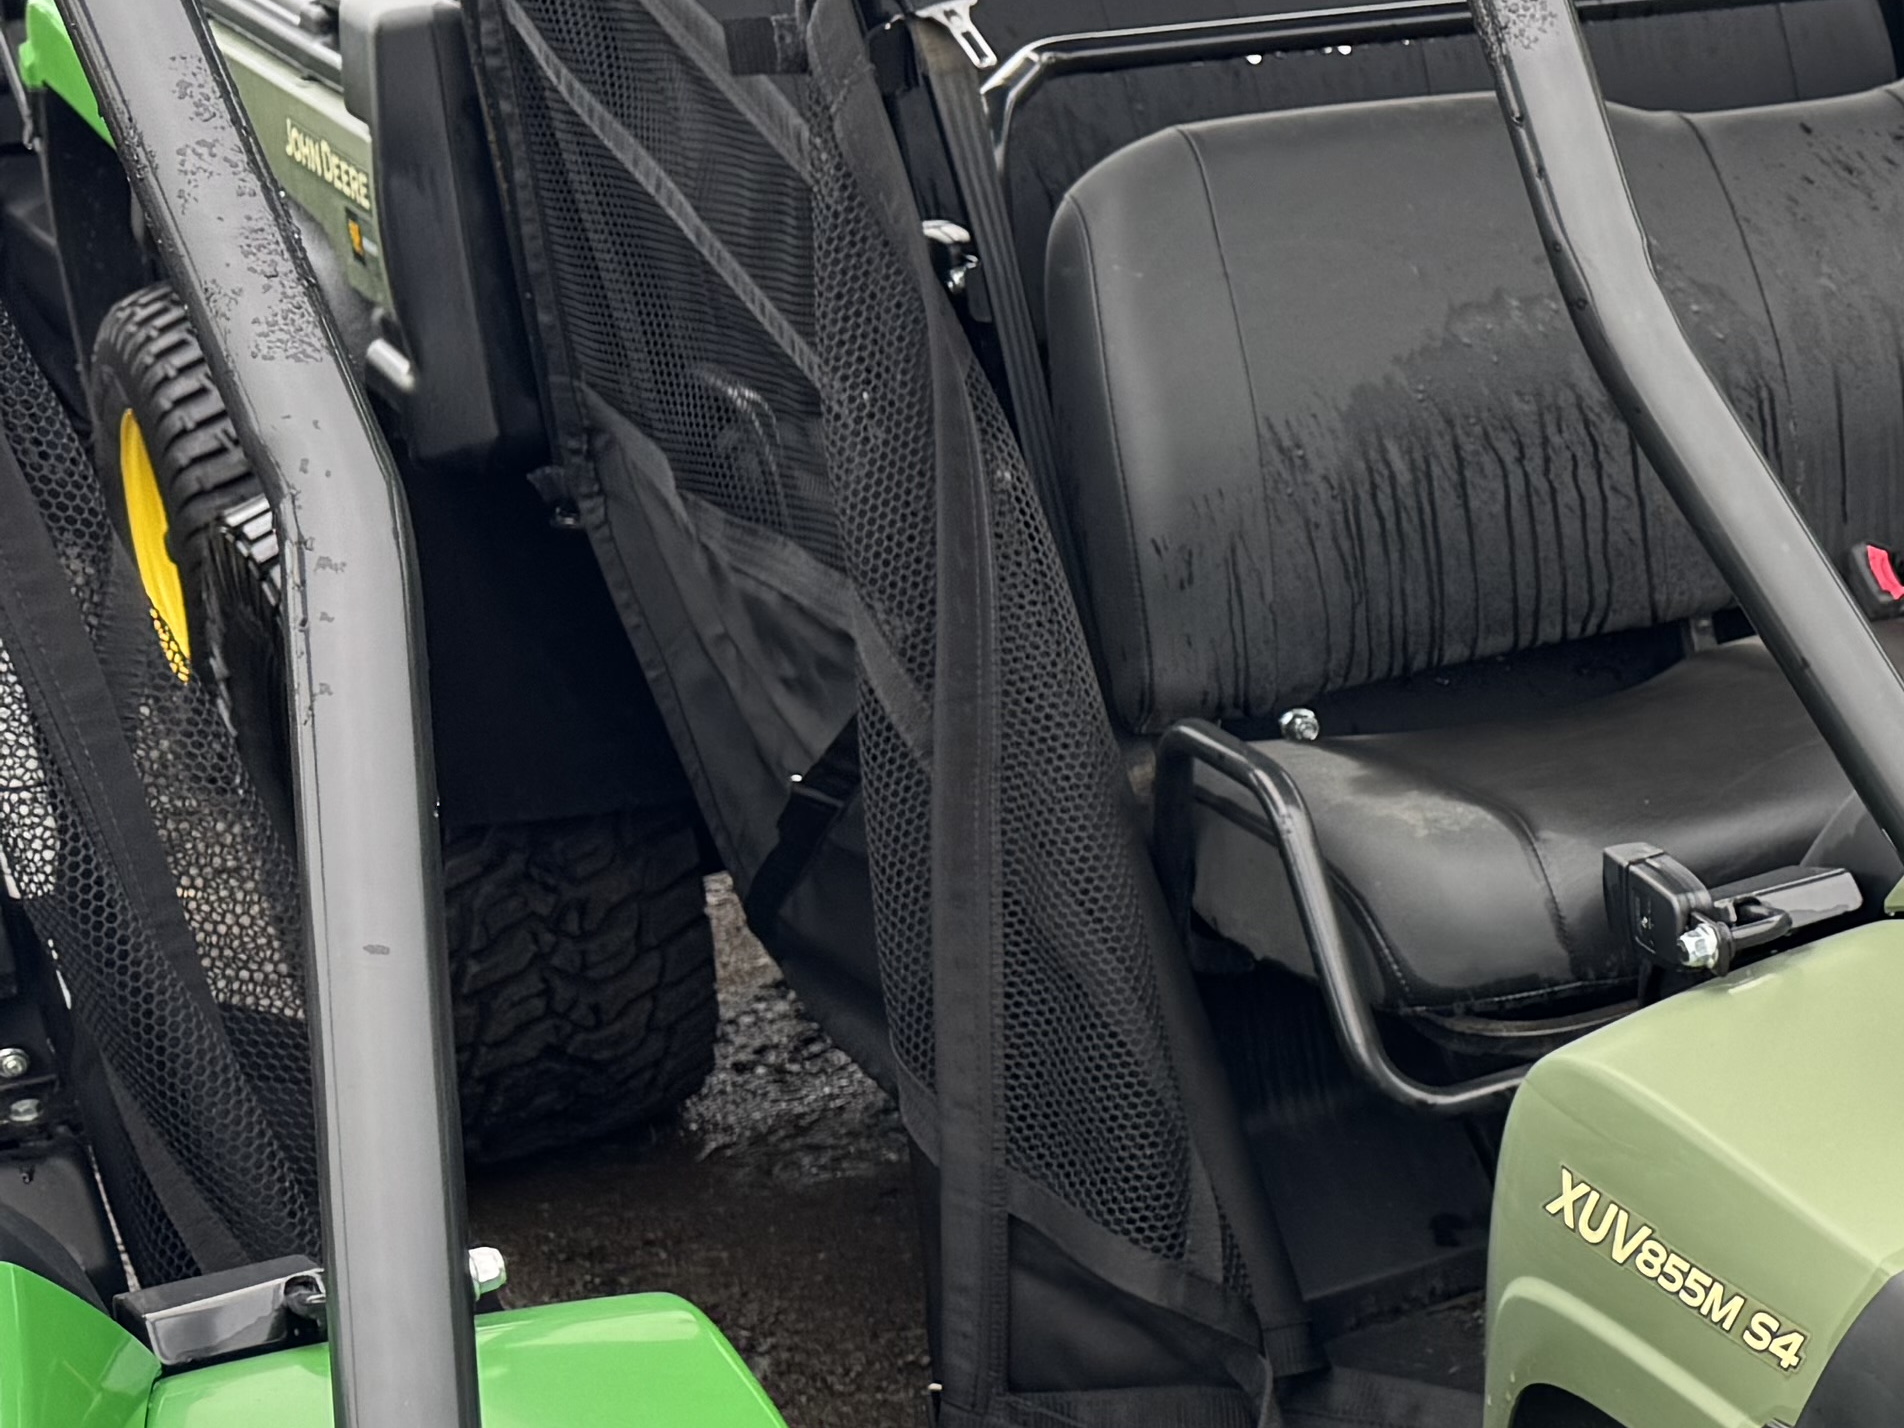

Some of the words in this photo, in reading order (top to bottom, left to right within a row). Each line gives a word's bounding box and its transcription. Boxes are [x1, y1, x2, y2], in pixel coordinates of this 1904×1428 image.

[285, 117, 322, 178] JOHN
[320, 139, 371, 211] DEERE
[1543, 1166, 1746, 1332] XUV855M
[1742, 1310, 1805, 1369] S4
